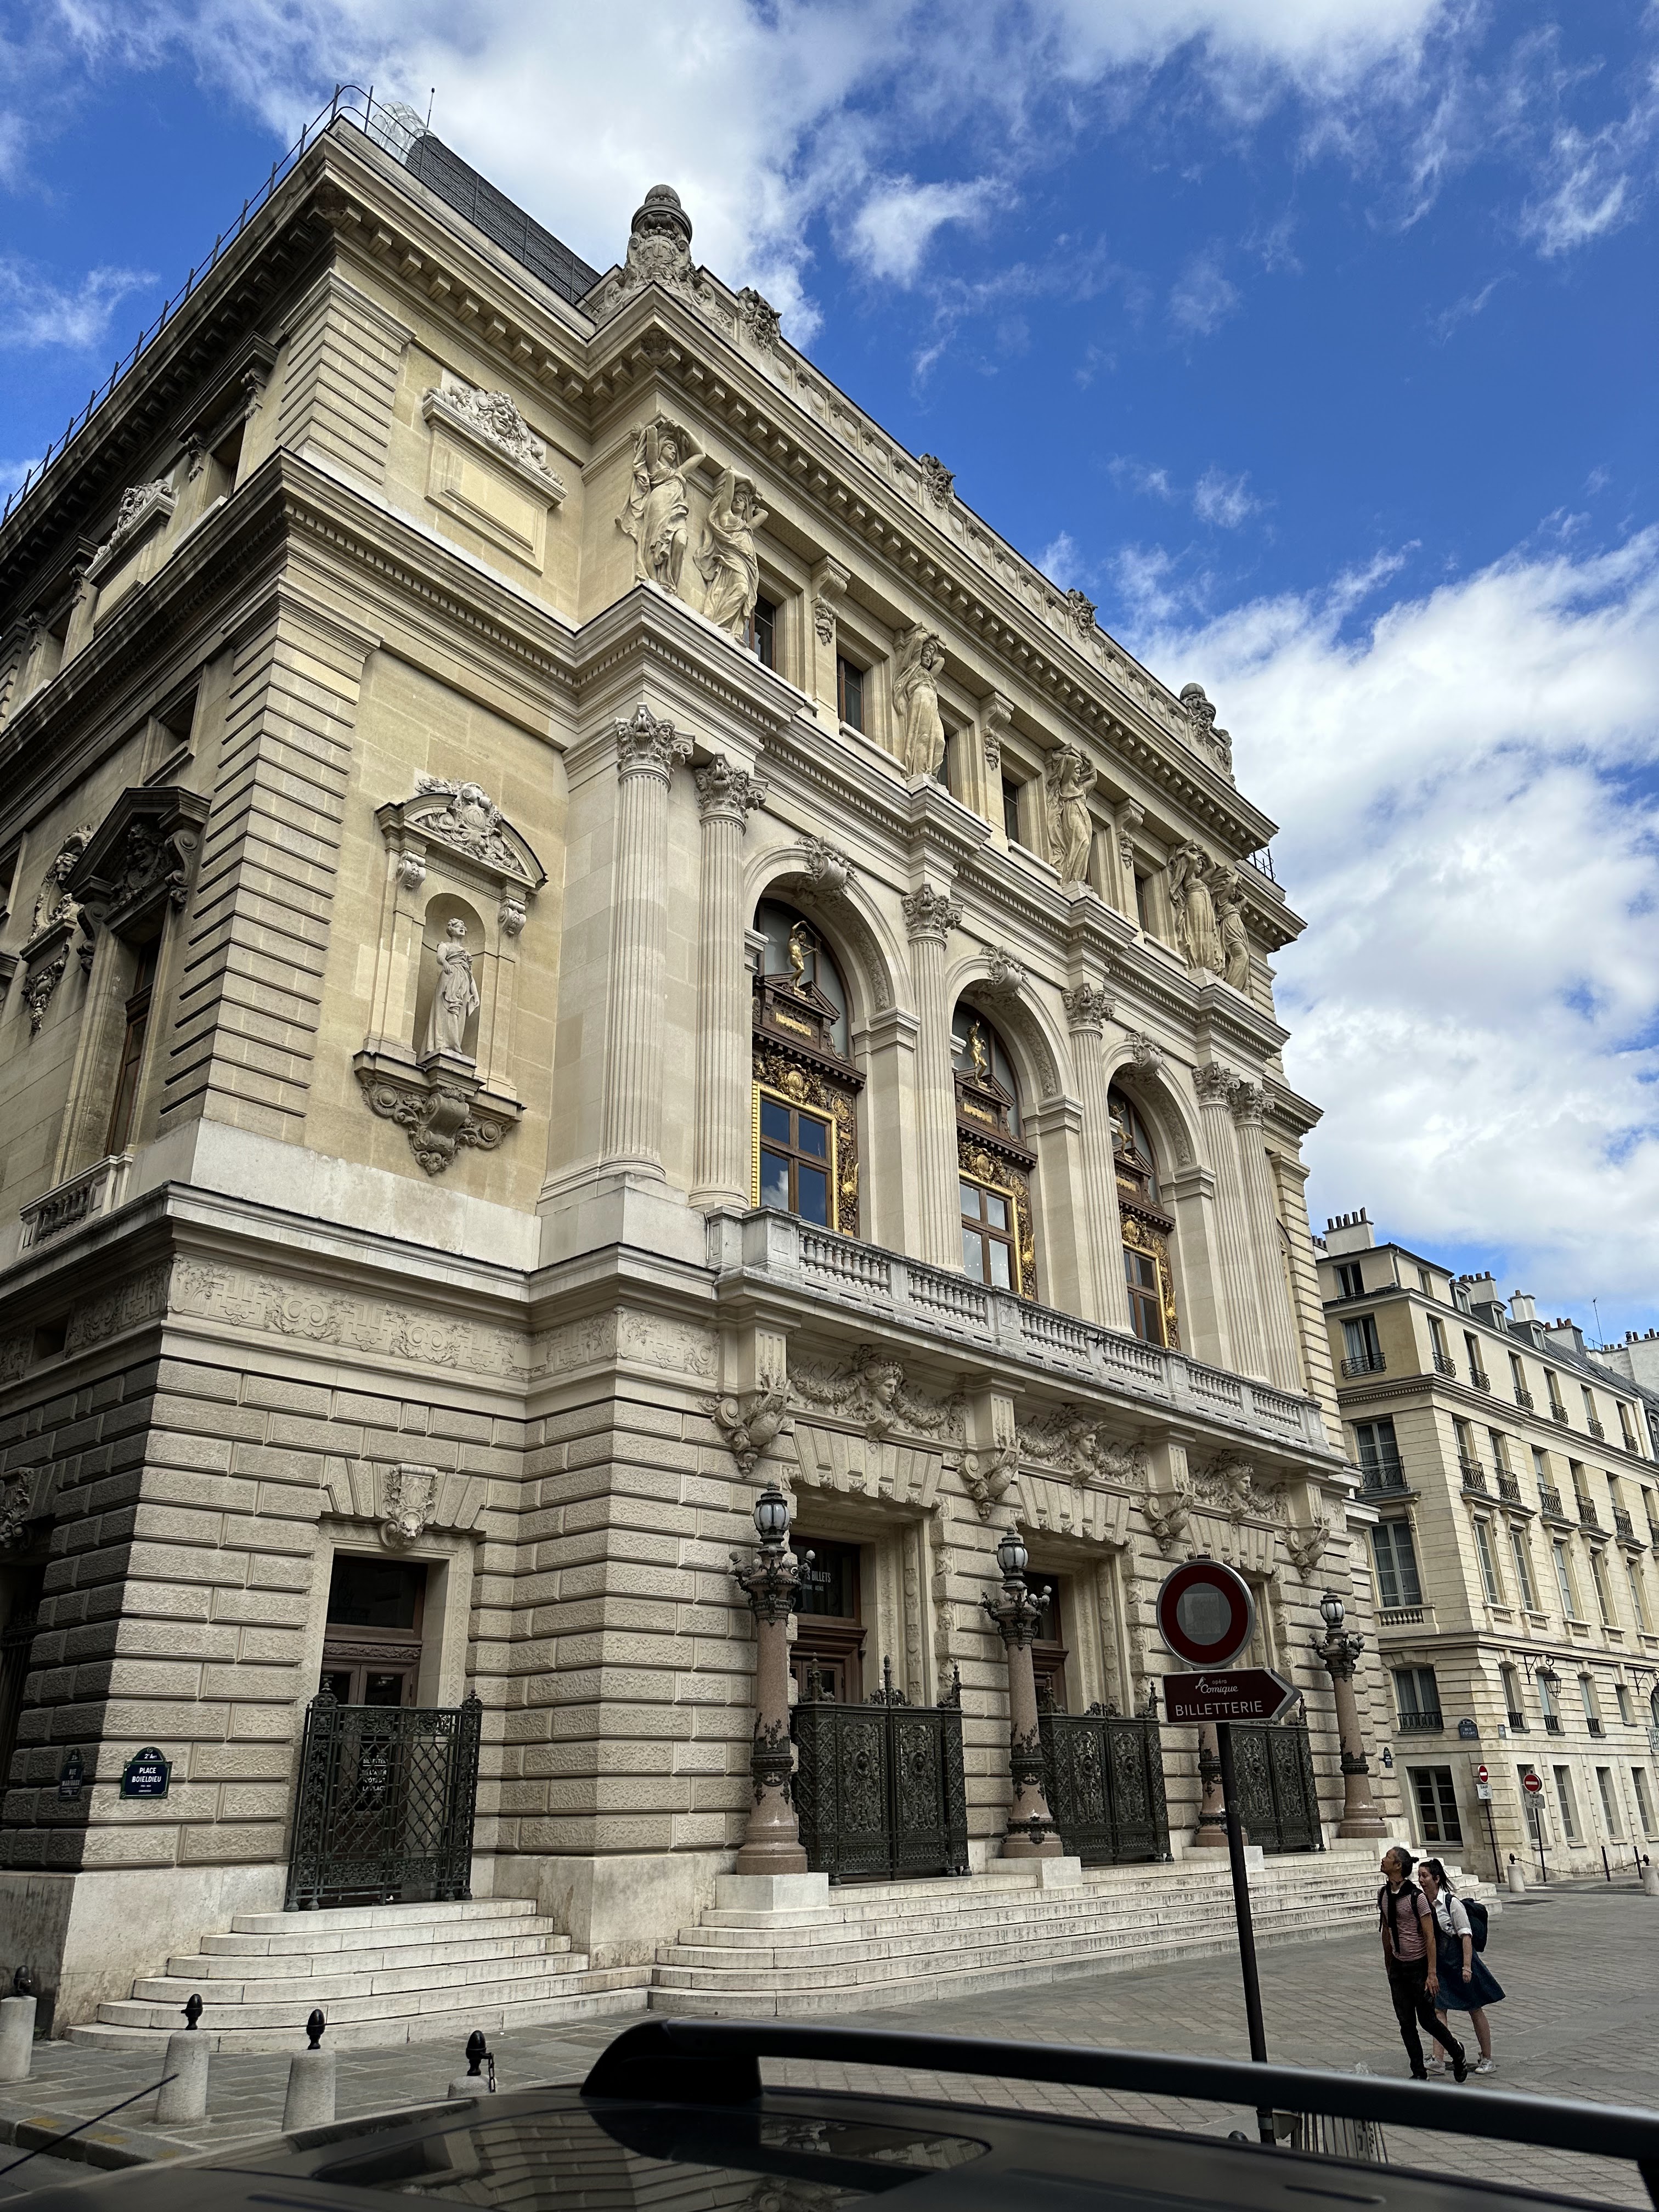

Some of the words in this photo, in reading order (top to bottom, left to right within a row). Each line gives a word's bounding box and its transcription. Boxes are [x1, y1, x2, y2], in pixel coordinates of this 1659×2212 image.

[811, 1571, 831, 1583] BILLETS
[1200, 1684, 1239, 1695] Comique
[1175, 1701, 1263, 1717] BILLETTERIE
